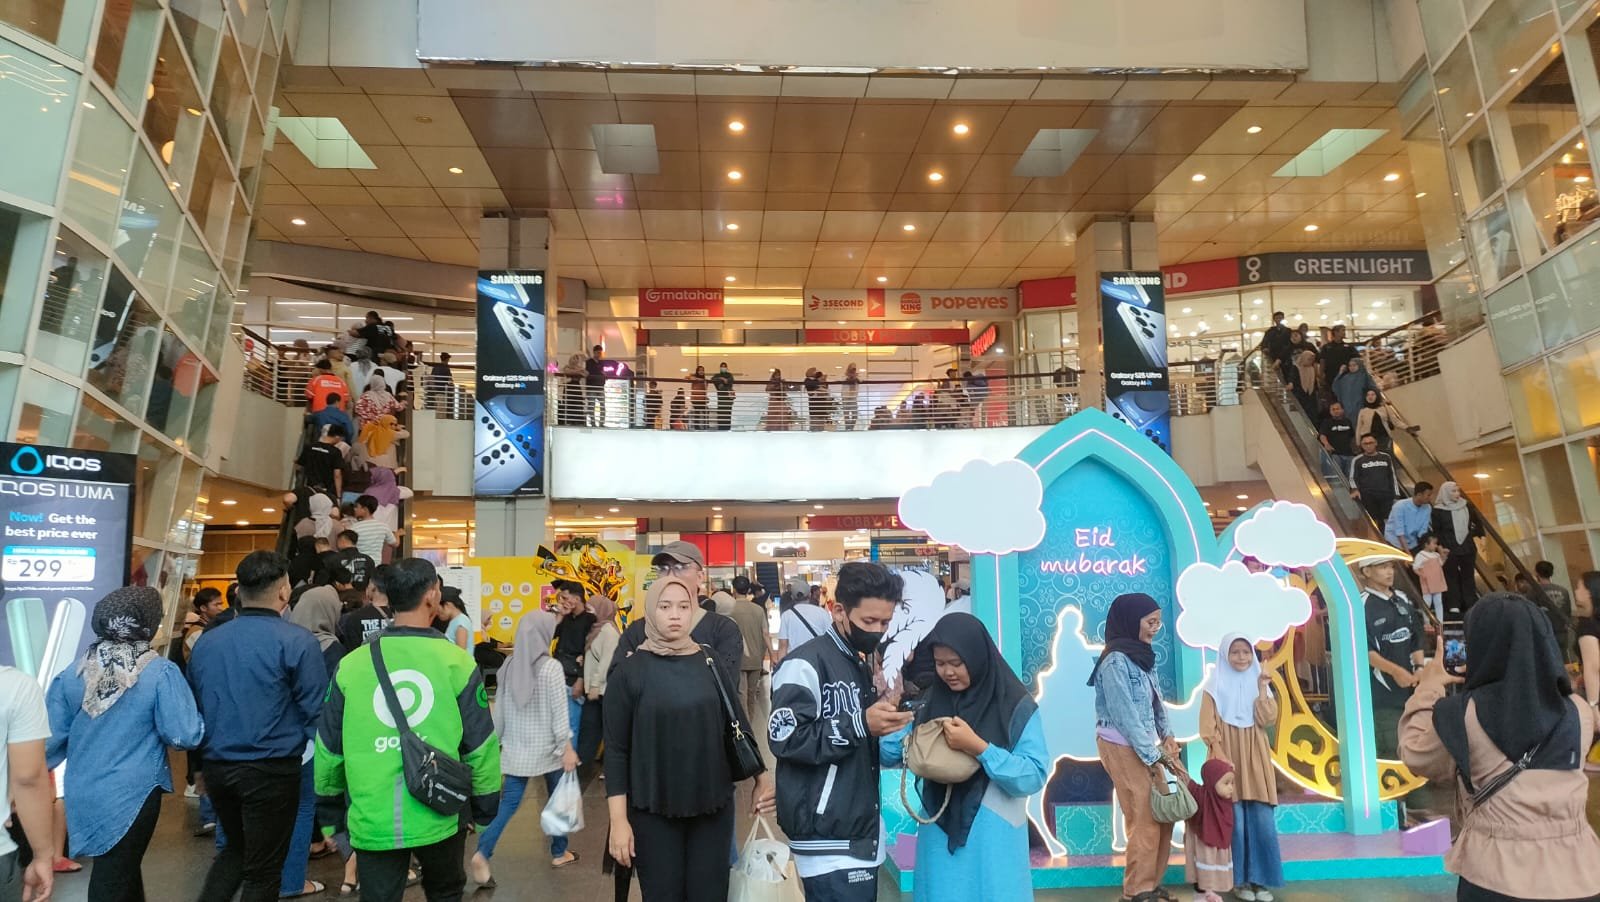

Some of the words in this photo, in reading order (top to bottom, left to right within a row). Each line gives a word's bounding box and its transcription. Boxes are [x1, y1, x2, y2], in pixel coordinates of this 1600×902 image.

[1294, 257, 1414, 274] GREENLIGHT
[490, 275, 543, 285] SAMSUNG
[1112, 276, 1161, 286] SAMSUNG
[900, 303, 921, 311] KING
[931, 296, 1008, 310] POPEYES
[834, 330, 876, 341] LOBBY
[46, 455, 101, 472] IQOS
[0, 480, 57, 496] QOS
[60, 484, 114, 500] ILUMA
[9, 511, 44, 522] Now!
[48, 513, 74, 524] Get
[75, 514, 96, 525] the
[5, 525, 36, 537] best
[37, 528, 70, 540] price
[71, 530, 98, 540] ever
[1075, 526, 1116, 548] Eid
[19, 559, 62, 577] 299
[1041, 551, 1146, 576] mubarak
[361, 619, 380, 630] THE
